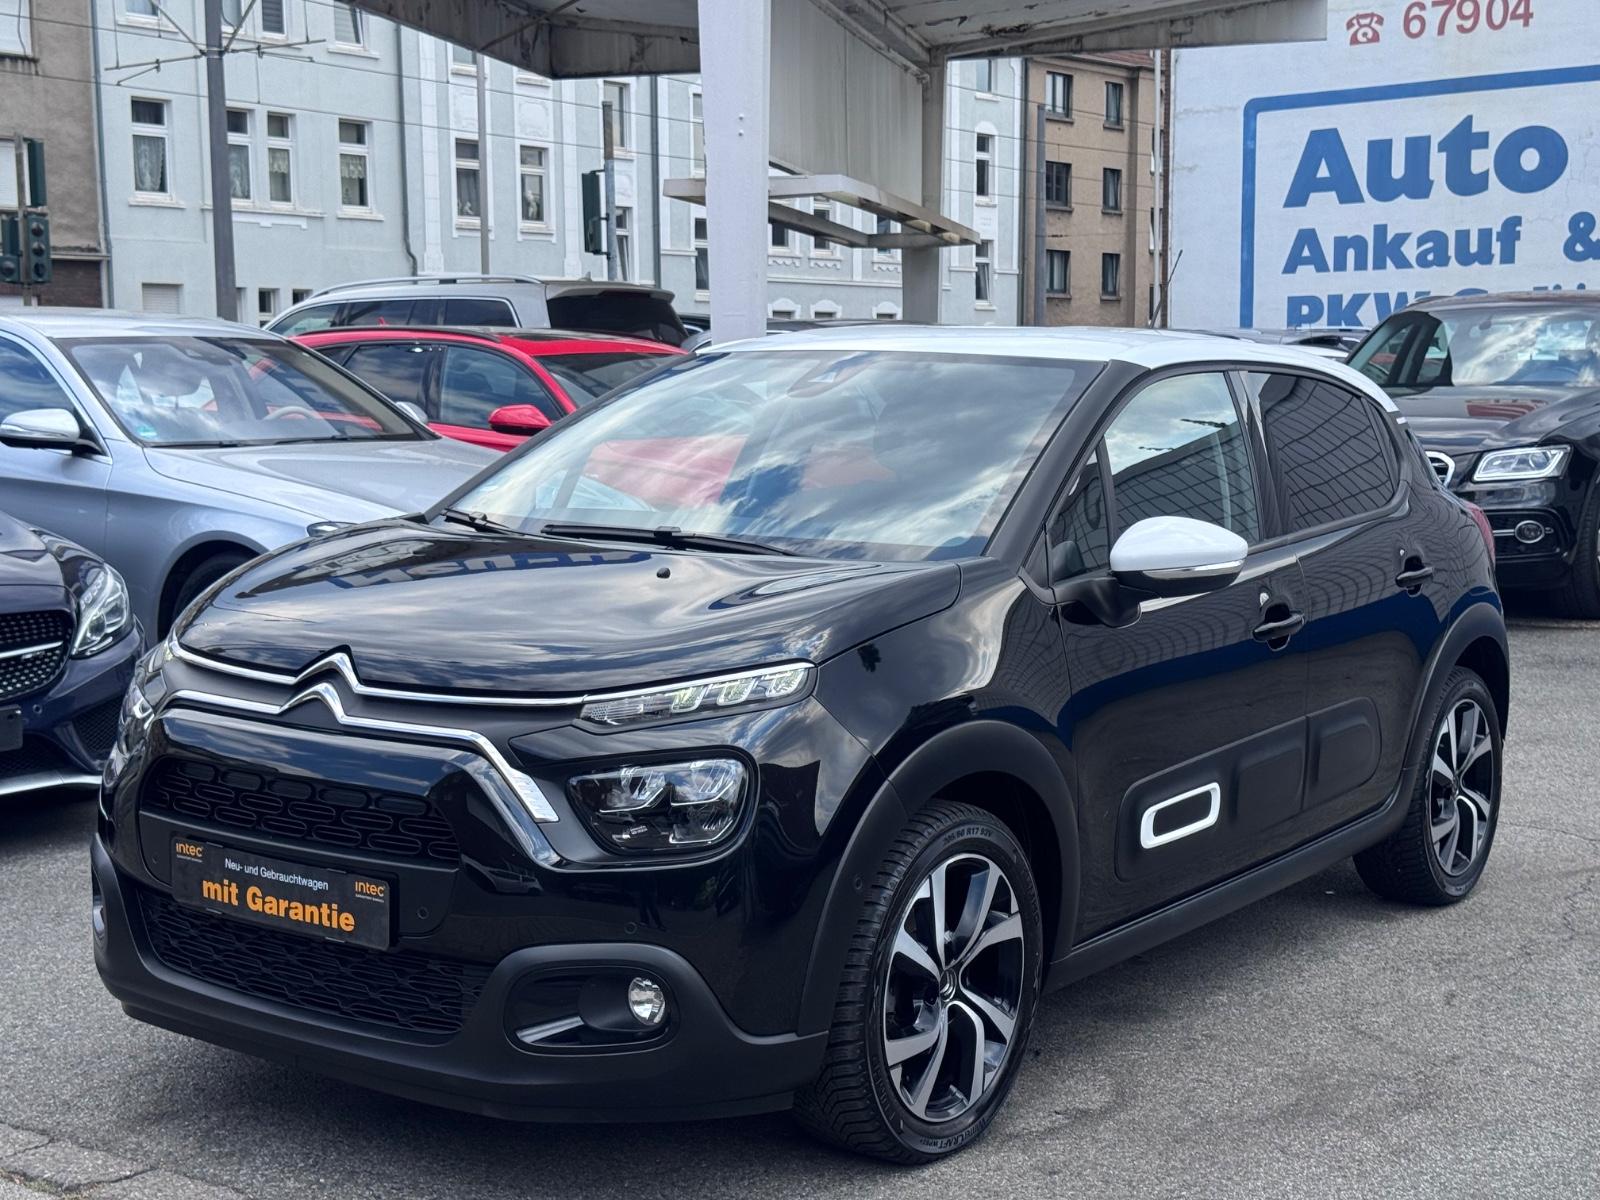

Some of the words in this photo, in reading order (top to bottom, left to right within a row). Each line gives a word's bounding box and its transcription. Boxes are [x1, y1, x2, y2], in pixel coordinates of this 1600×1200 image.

[1403, 0, 1534, 39] 67904
[1282, 114, 1569, 208] Auto
[1281, 215, 1523, 275] Ankauf
[1563, 211, 1600, 263] &
[225, 858, 243, 872] Neu-
[244, 862, 259, 876] und
[260, 866, 329, 891] Gebrauchtwagen
[202, 879, 239, 906] mit
[246, 885, 356, 932] Garantie
